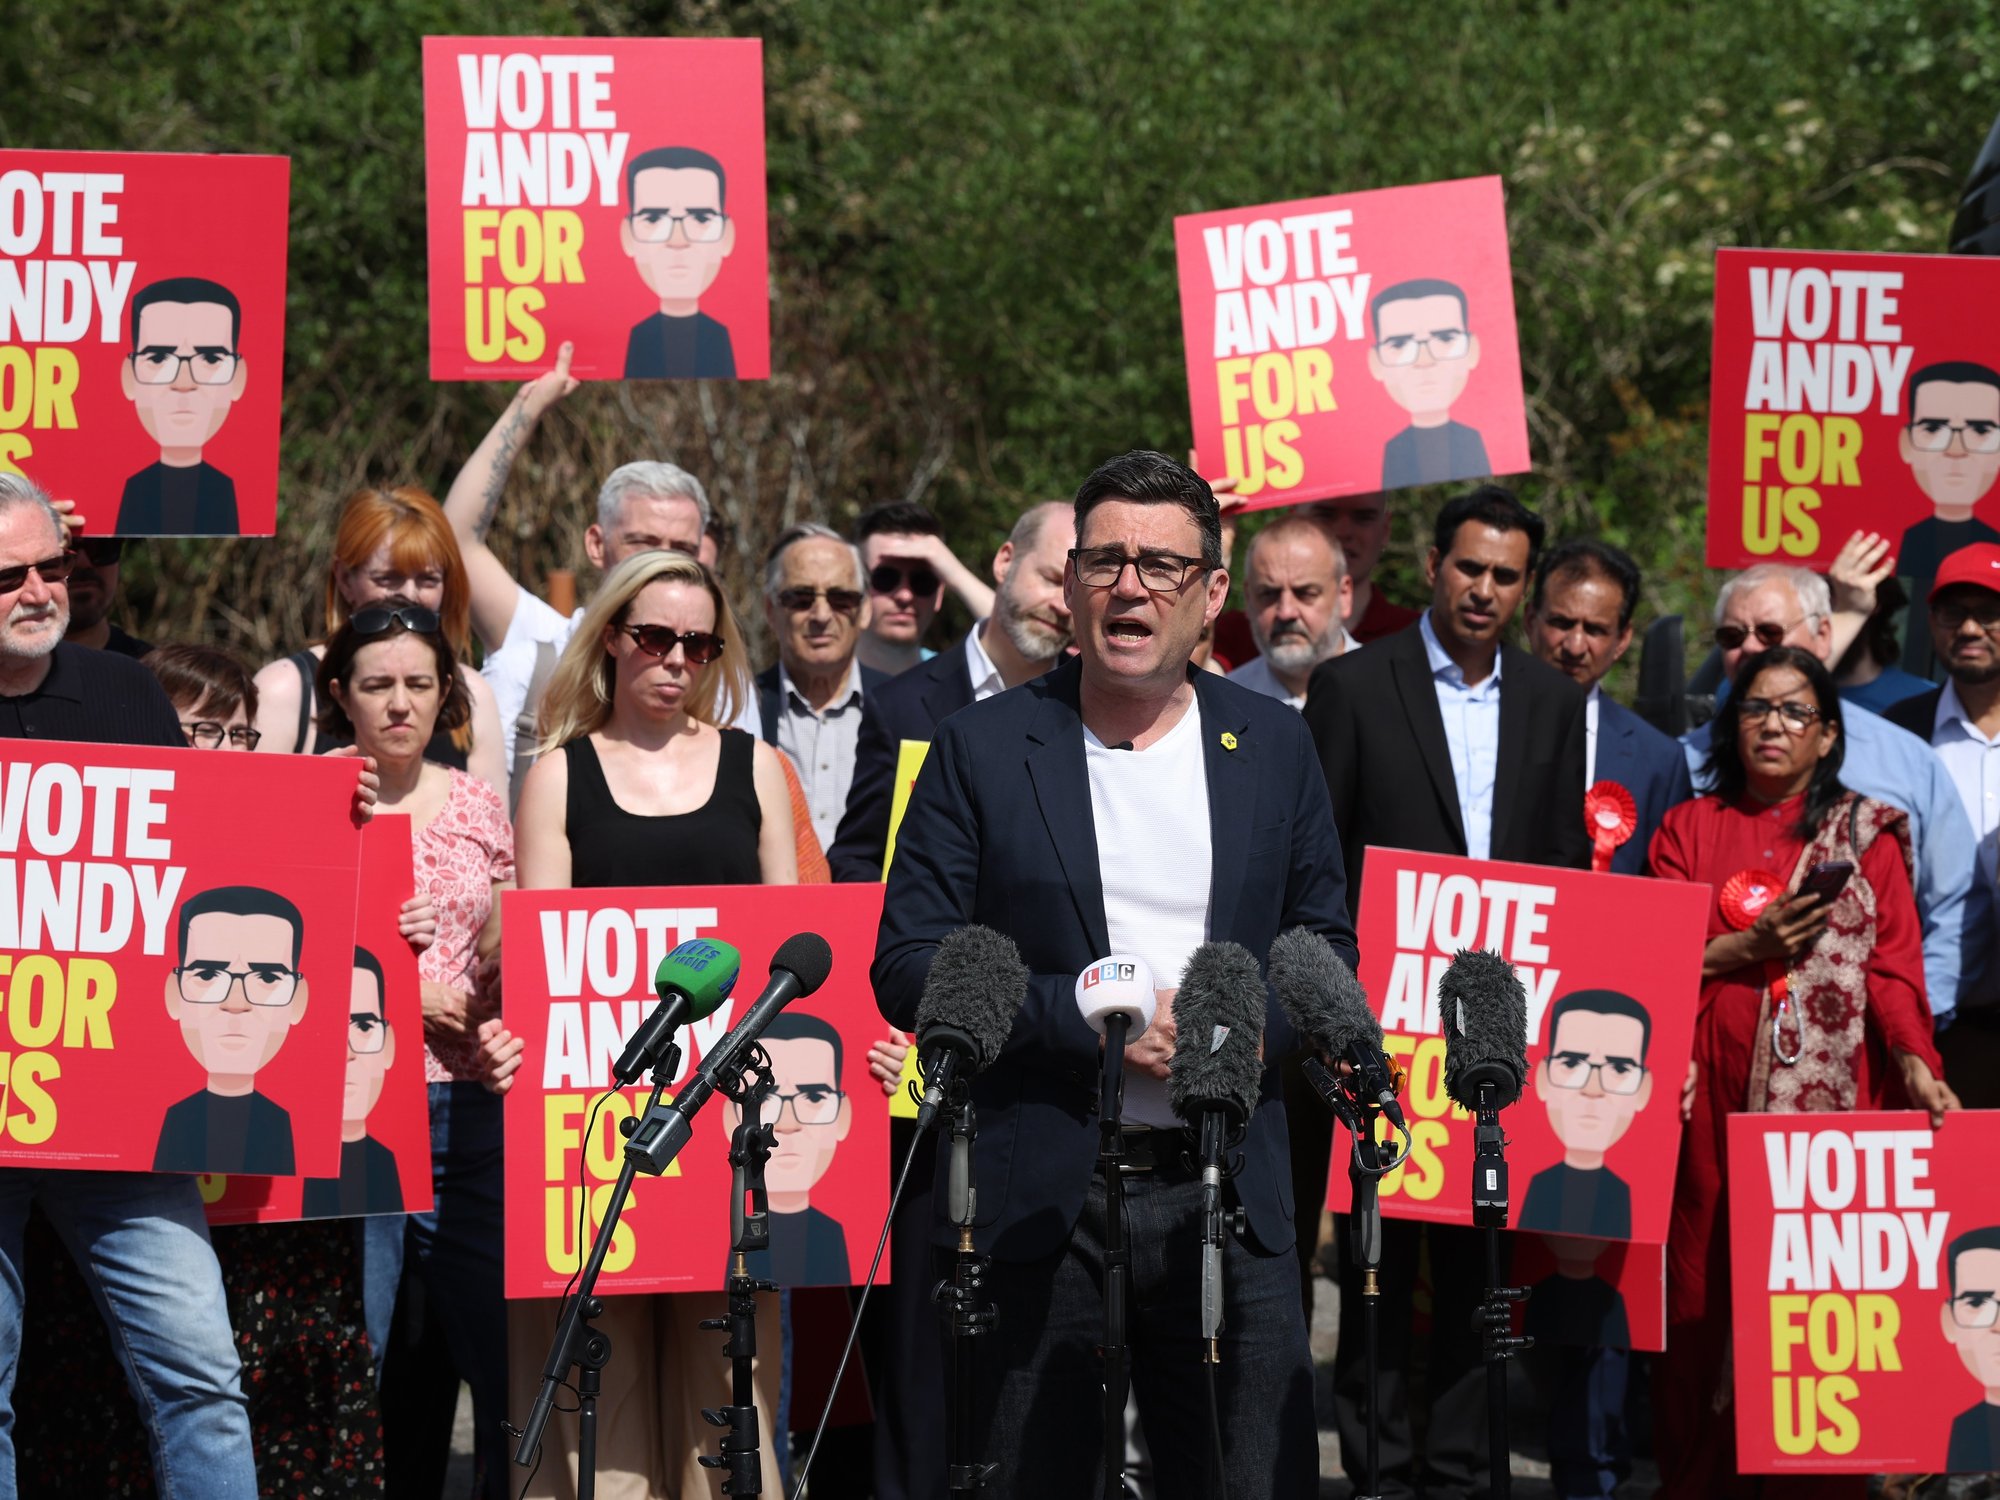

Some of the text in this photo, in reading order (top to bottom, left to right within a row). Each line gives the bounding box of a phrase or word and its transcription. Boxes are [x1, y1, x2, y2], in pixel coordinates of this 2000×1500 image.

[458, 52, 617, 131] VOTE
[461, 131, 631, 207] ANDY
[0, 169, 124, 256] OTE
[464, 209, 585, 285] FOR
[1203, 209, 1357, 292] VOTE
[0, 259, 137, 343] NDY
[465, 286, 546, 363] US
[1212, 272, 1372, 359] ANDY
[1748, 267, 1904, 342] VOTE
[0, 345, 79, 430] OR
[1217, 348, 1337, 427] FOR
[1745, 340, 1914, 415] ANDY
[1223, 419, 1305, 496] US
[1744, 414, 1862, 487] FOR
[1742, 485, 1821, 556] US
[1393, 869, 1557, 964] VOTE
[0, 954, 117, 1050] OR
[1085, 963, 1134, 988] LBC
[1379, 952, 1561, 1046] AY
[0, 1050, 61, 1145] S
[1763, 1130, 1936, 1210] VOTE
[544, 1184, 636, 1274] US
[1768, 1211, 1950, 1291] ANDY
[1769, 1292, 1902, 1373] FOR
[1772, 1374, 1861, 1455] US
